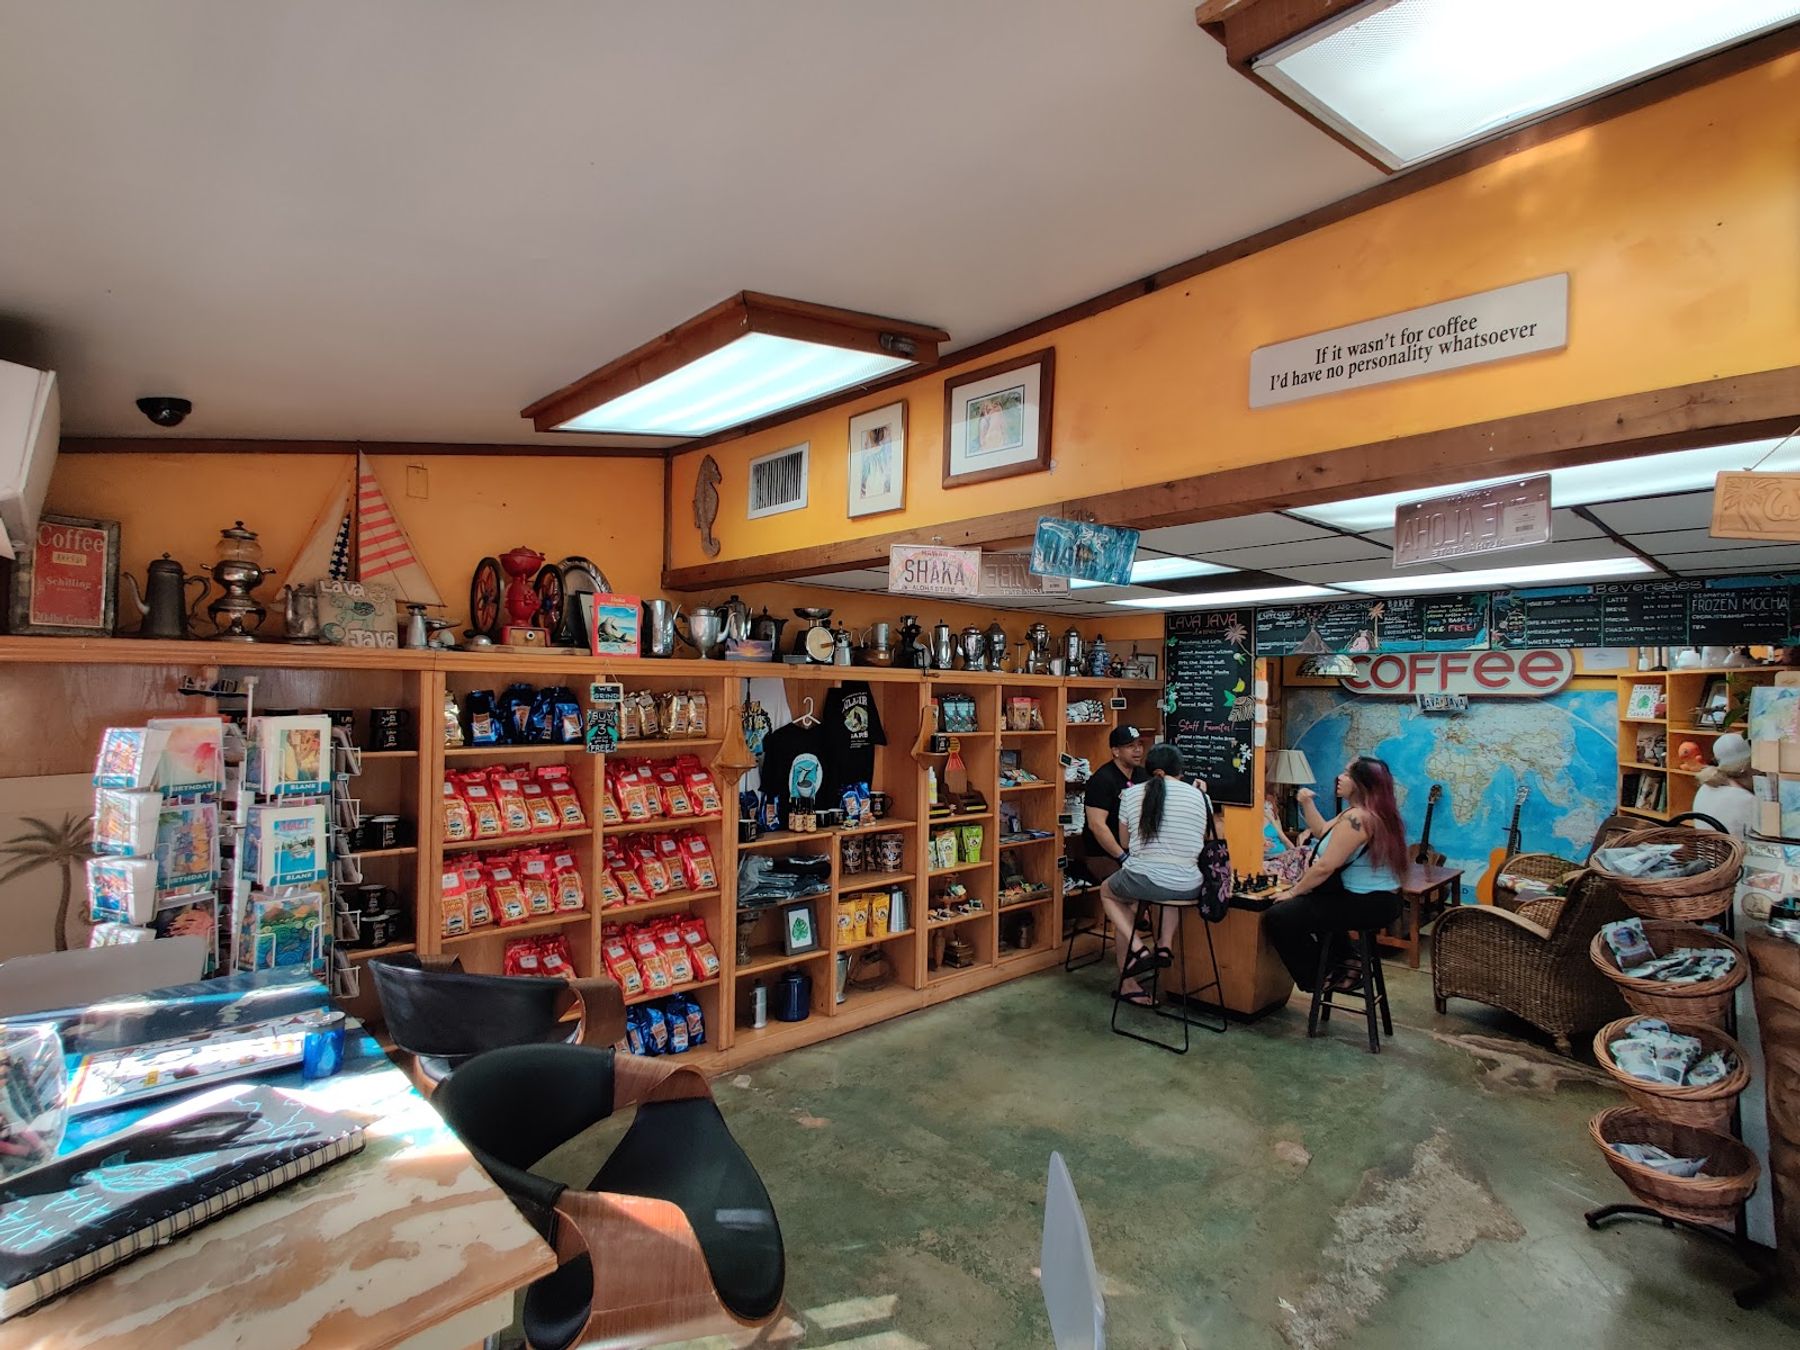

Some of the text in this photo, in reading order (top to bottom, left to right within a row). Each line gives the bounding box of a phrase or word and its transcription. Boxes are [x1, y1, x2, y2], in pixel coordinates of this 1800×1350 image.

[1315, 315, 1478, 365] If it wasn't for coffee
[1269, 321, 1538, 391] I'd have no personality whatsoever
[38, 525, 104, 553] Coffee
[904, 559, 965, 585] SHAKA
[320, 581, 365, 597] Lava
[1596, 580, 1702, 594] Beverages
[1692, 597, 1788, 612] FROZEN MOCHA
[1168, 612, 1238, 630] LAVA JAVA
[350, 630, 397, 648] Java
[592, 712, 613, 721] BUY
[598, 724, 606, 735] 3
[1178, 719, 1199, 732] Staff
[286, 872, 313, 881] BLANK
